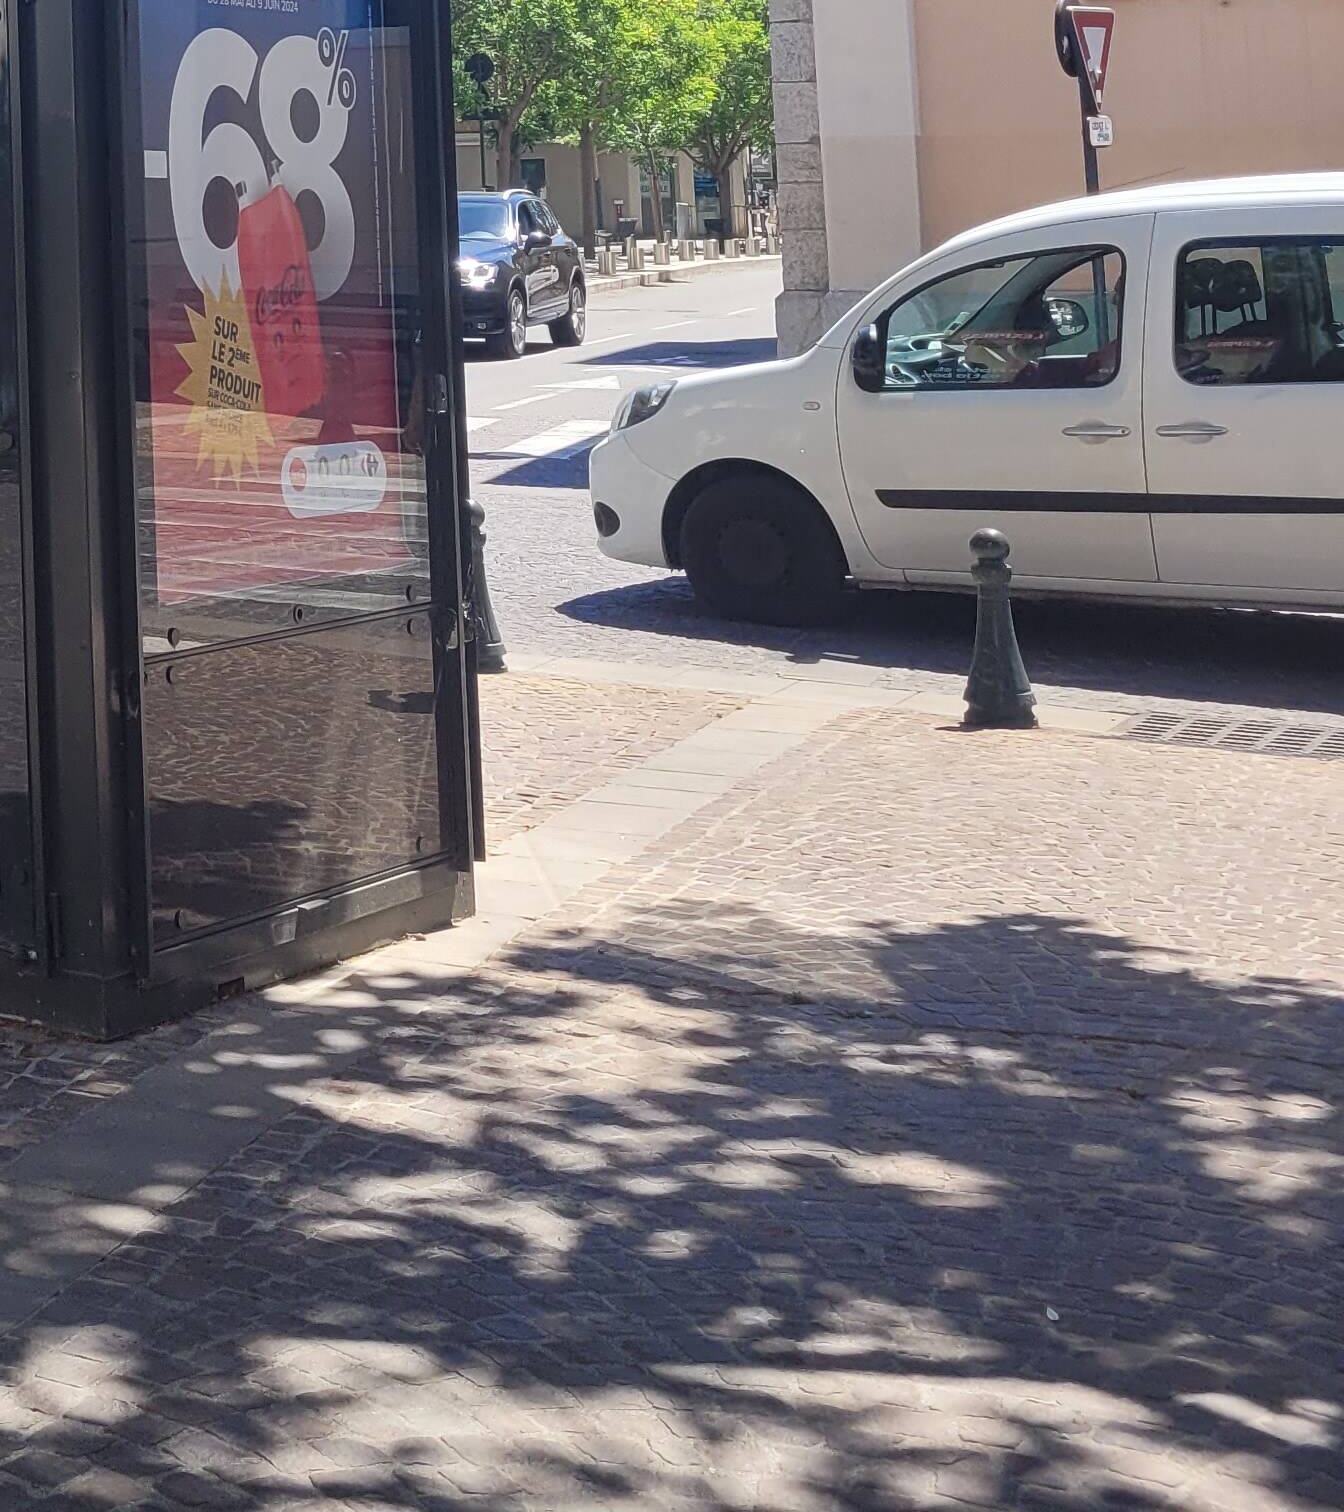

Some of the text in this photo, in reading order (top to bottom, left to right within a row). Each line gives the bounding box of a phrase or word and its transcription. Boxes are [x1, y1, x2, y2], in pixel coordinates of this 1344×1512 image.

[264, 0, 281, 11] JUIN
[281, 1, 299, 13] 2024
[214, 315, 238, 341] SUR
[212, 340, 225, 364] LE
[209, 365, 262, 404] PRODUIT
